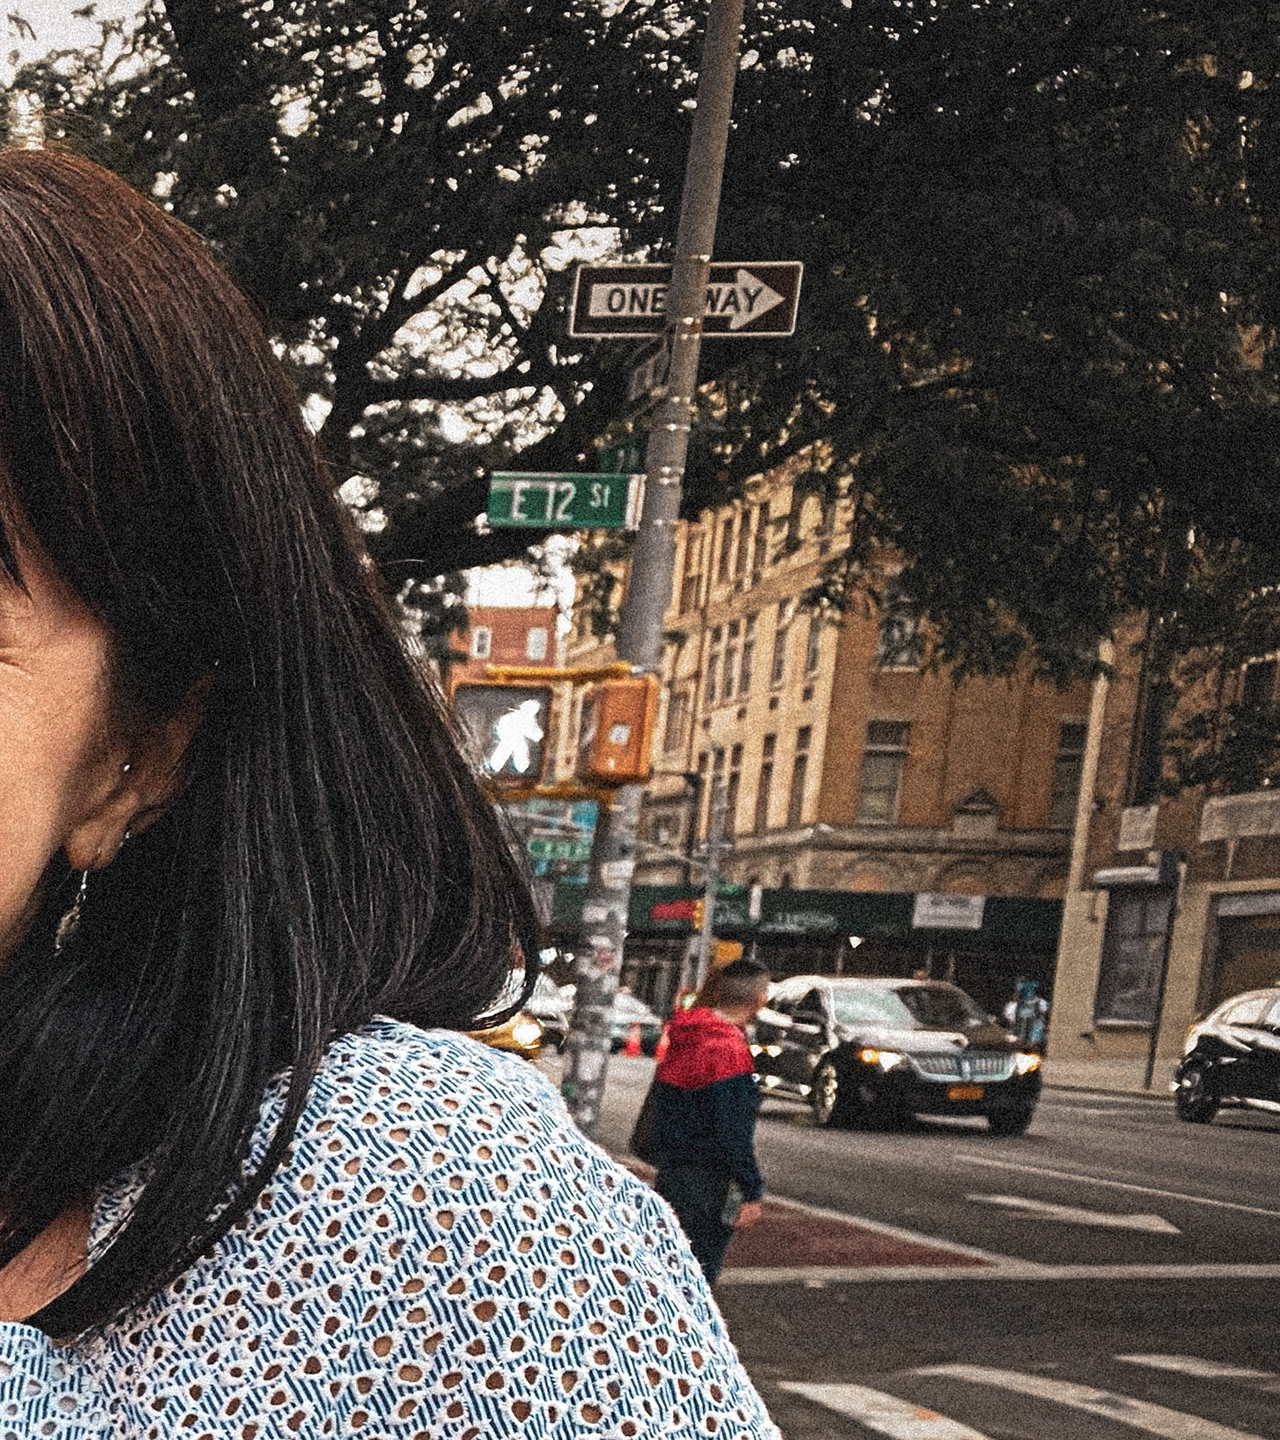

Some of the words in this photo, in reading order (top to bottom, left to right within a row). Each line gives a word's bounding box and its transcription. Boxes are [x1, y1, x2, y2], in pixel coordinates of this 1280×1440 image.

[607, 287, 668, 314] ONE
[511, 480, 532, 520] E
[544, 480, 578, 522] 12
